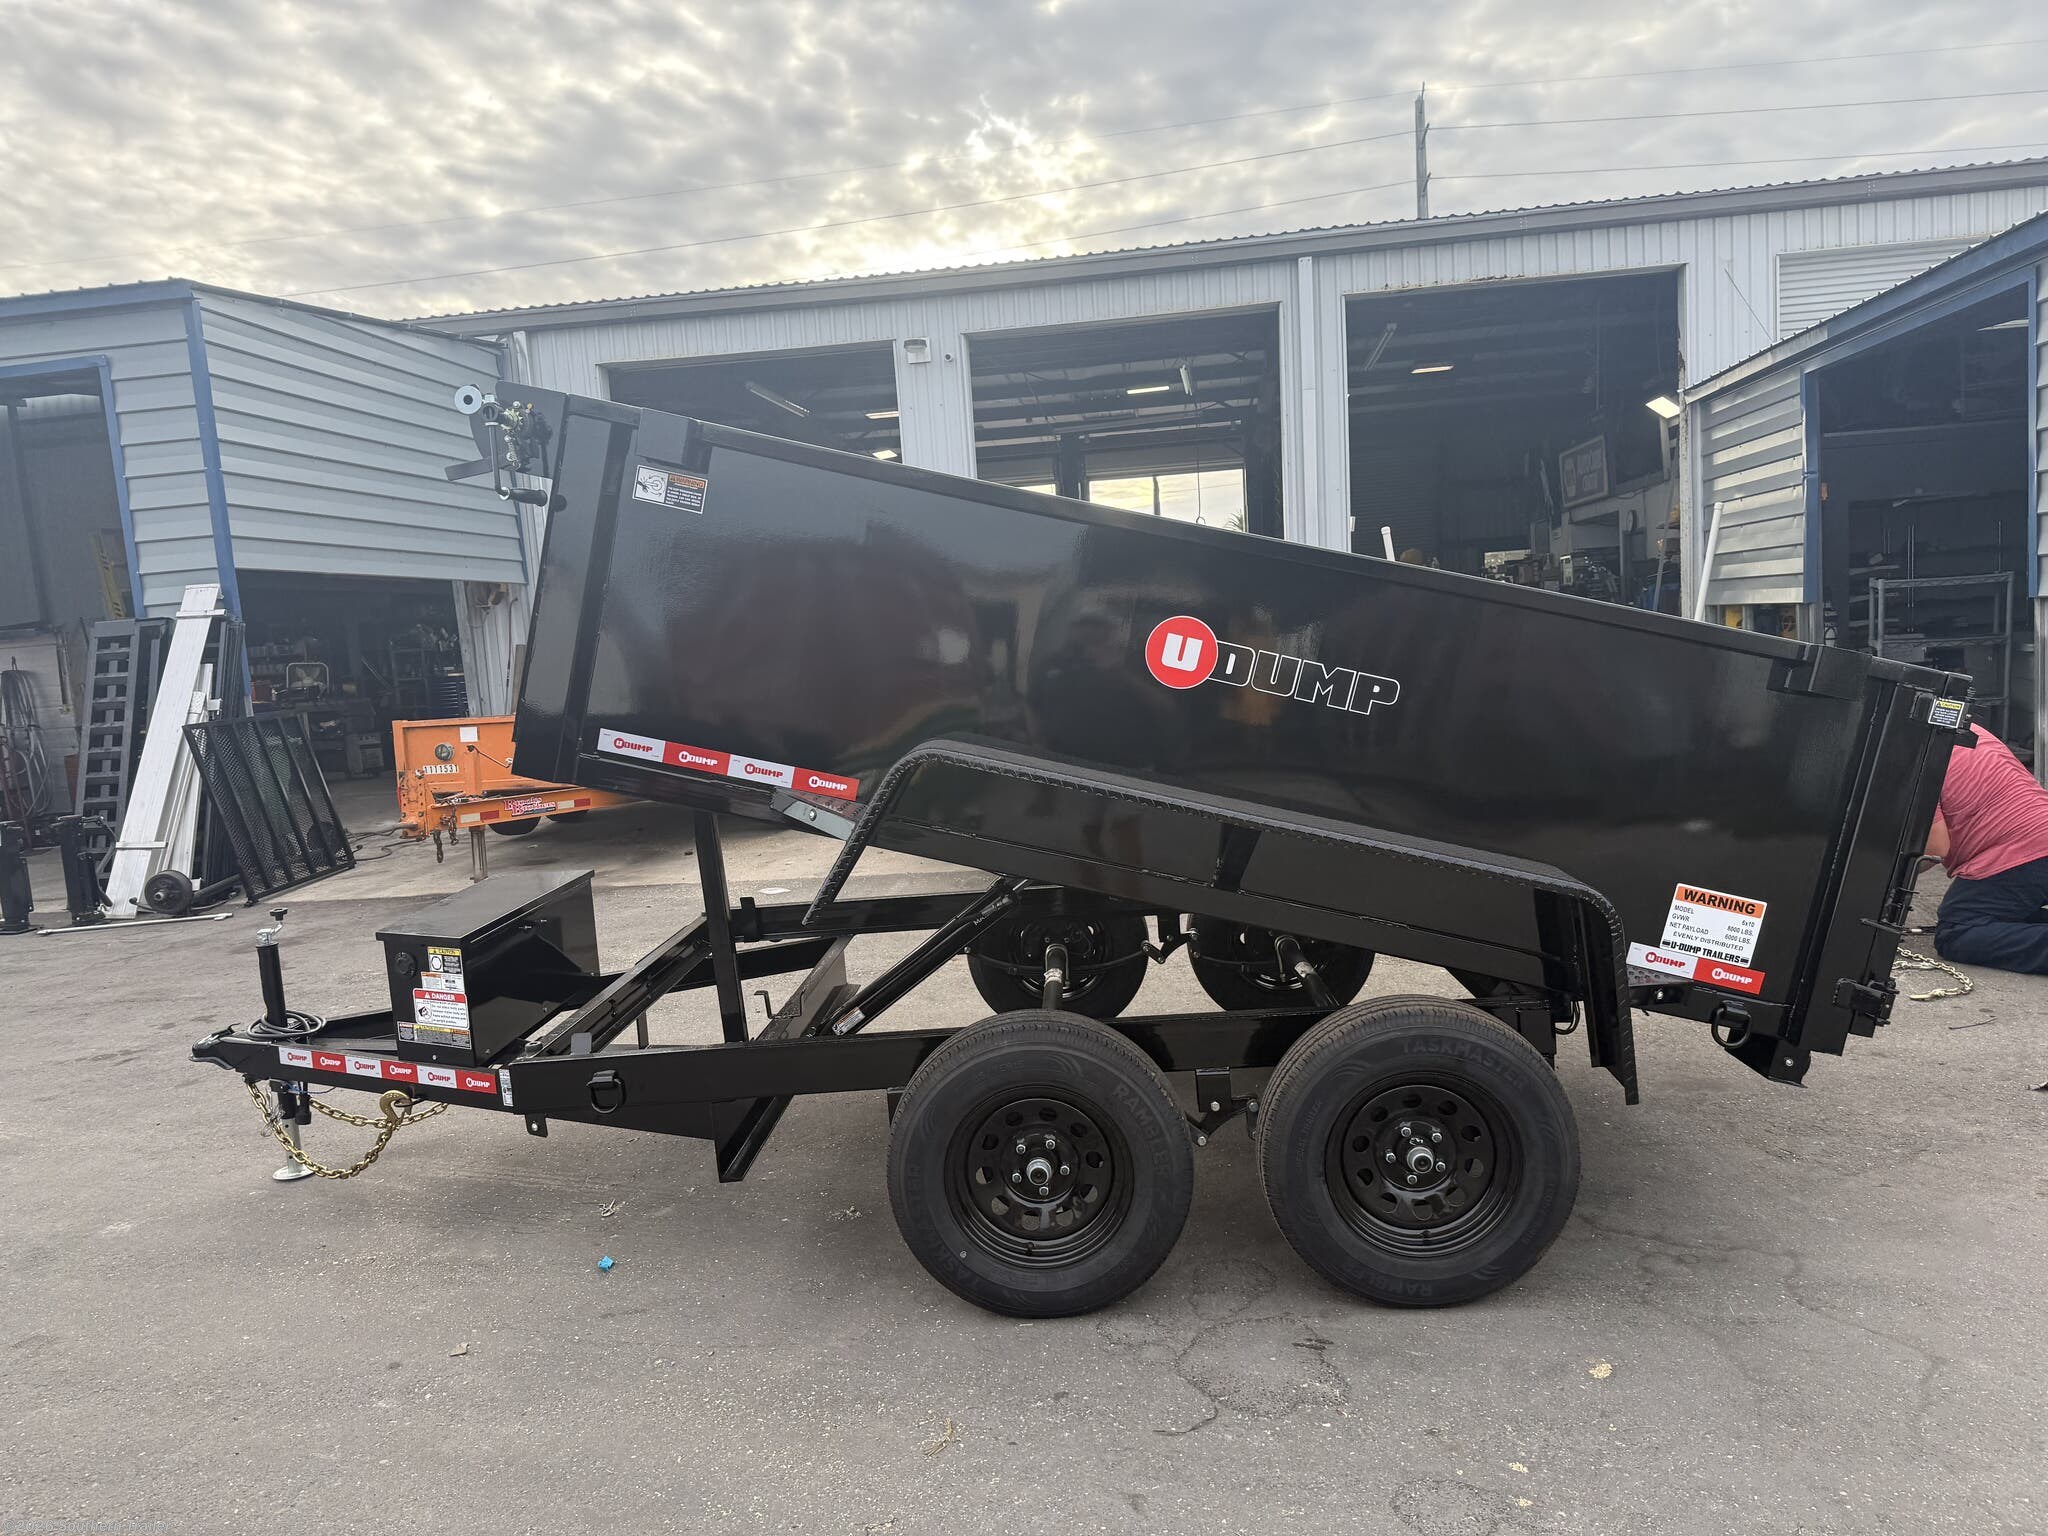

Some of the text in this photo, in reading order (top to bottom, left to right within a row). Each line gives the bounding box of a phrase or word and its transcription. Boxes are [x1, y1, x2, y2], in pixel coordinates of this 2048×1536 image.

[1674, 904, 1695, 915] MODEL
[1684, 888, 1755, 915] WARNING
[1671, 913, 1690, 922] GVWR
[1669, 921, 1681, 929] NET
[1682, 924, 1709, 935] PAYLOAD
[1673, 931, 1744, 952] EVENLY DISTRIBUTED
[1645, 951, 1686, 968] UDUMP
[1670, 941, 1741, 964] U-DUMP TRAILERS
[1711, 967, 1753, 985] UDUMP
[431, 993, 456, 1001] DANGER
